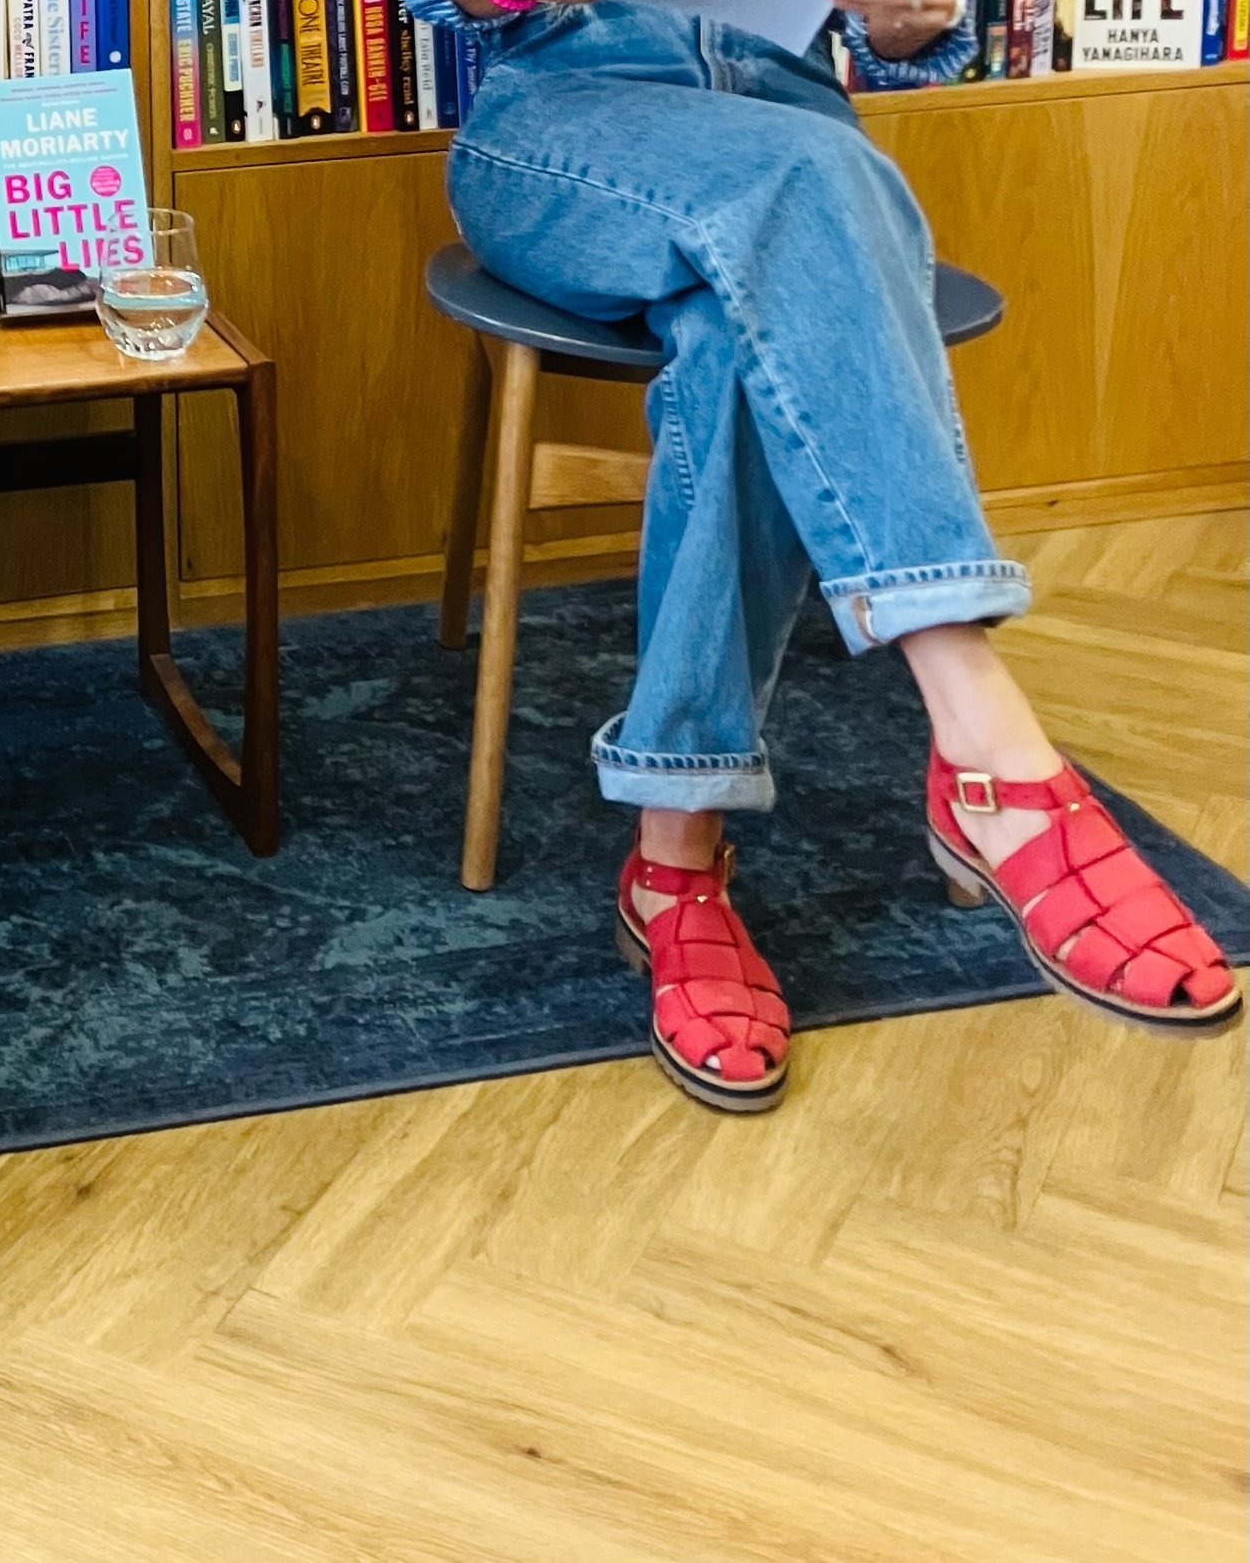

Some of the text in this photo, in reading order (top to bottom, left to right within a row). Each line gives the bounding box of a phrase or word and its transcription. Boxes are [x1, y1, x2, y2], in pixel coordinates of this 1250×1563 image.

[1108, 28, 1159, 43] HANYA
[1082, 47, 1183, 61] YANAGIHARA
[26, 107, 98, 133] LIANE
[0, 129, 128, 159] MORIARTY
[5, 171, 72, 204] BIG
[8, 199, 138, 240] LITTLE
[58, 235, 144, 272] LIES
